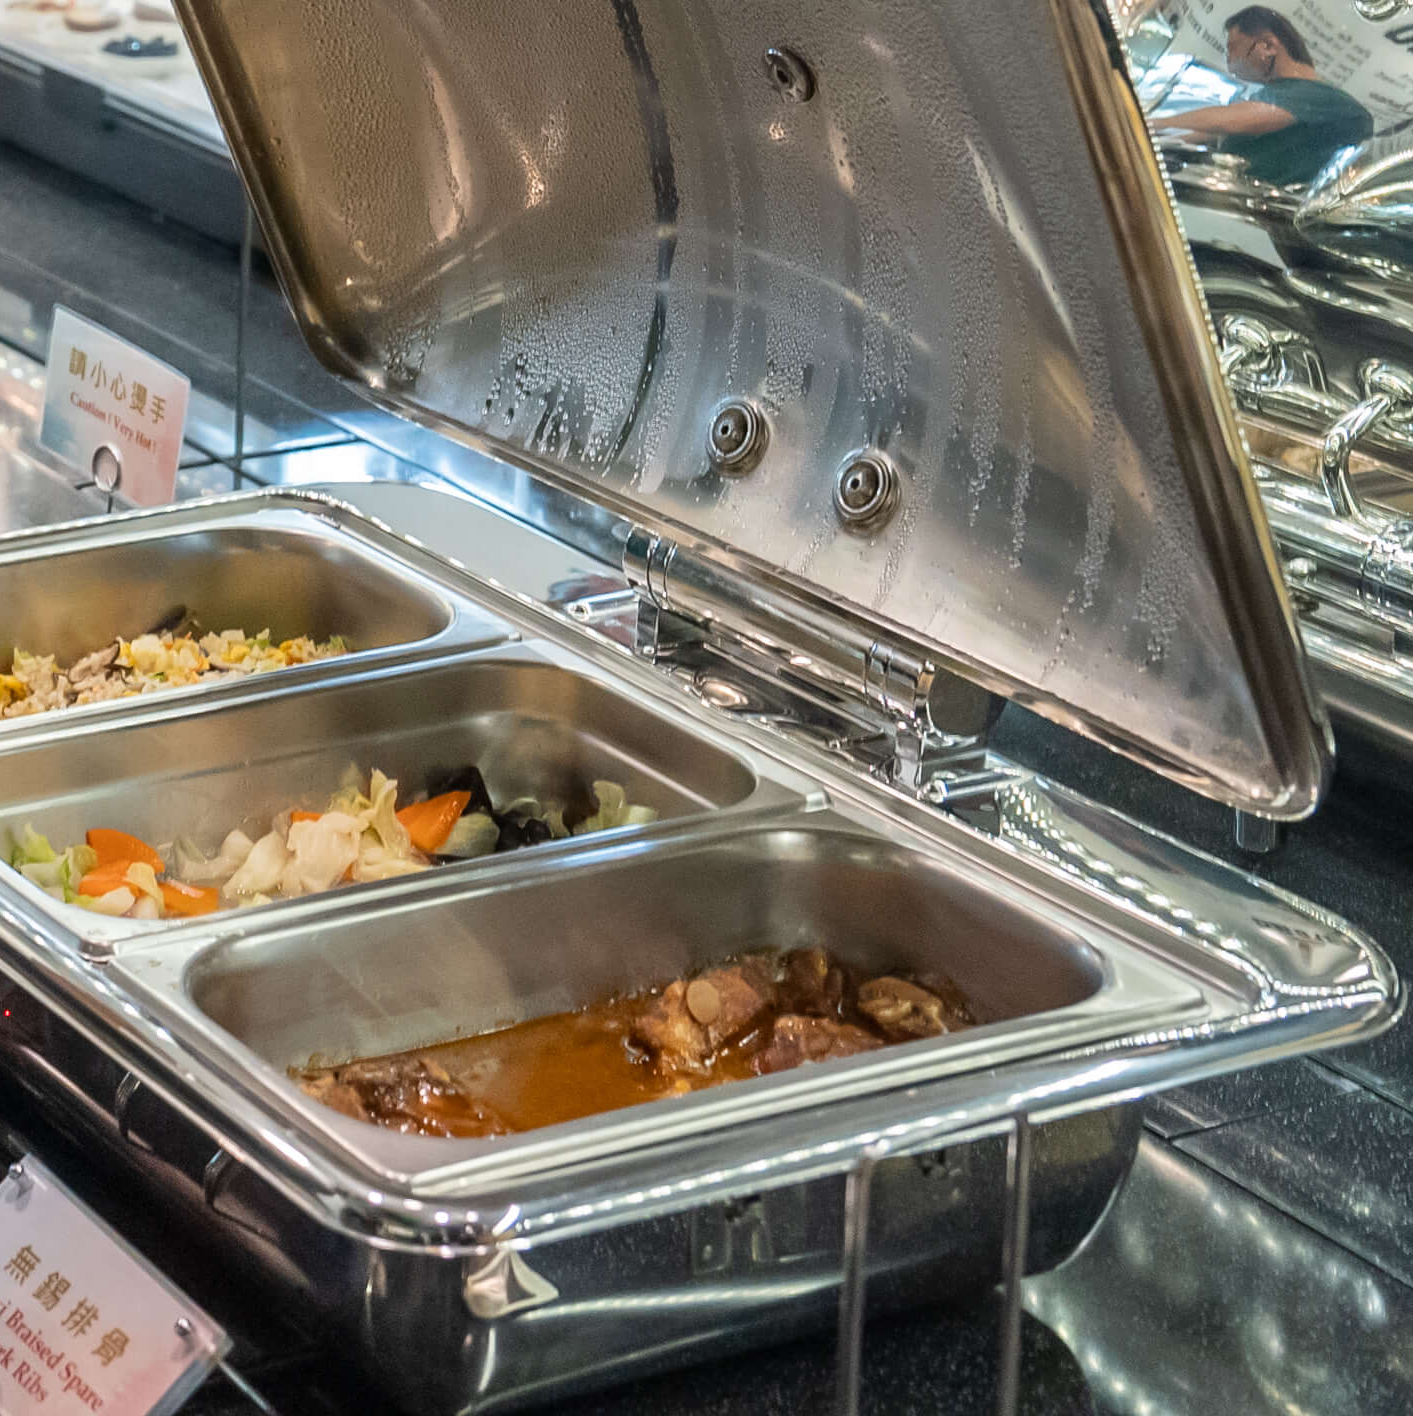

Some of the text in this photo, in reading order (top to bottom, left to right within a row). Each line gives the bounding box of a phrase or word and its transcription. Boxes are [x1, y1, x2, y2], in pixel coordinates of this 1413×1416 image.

[68, 346, 166, 425] 請小心燙手
[3, 1243, 130, 1367] 無錫排骨
[5, 1307, 65, 1369] Braised
[58, 1360, 104, 1412] Spare
[12, 1357, 49, 1403] Ribs
